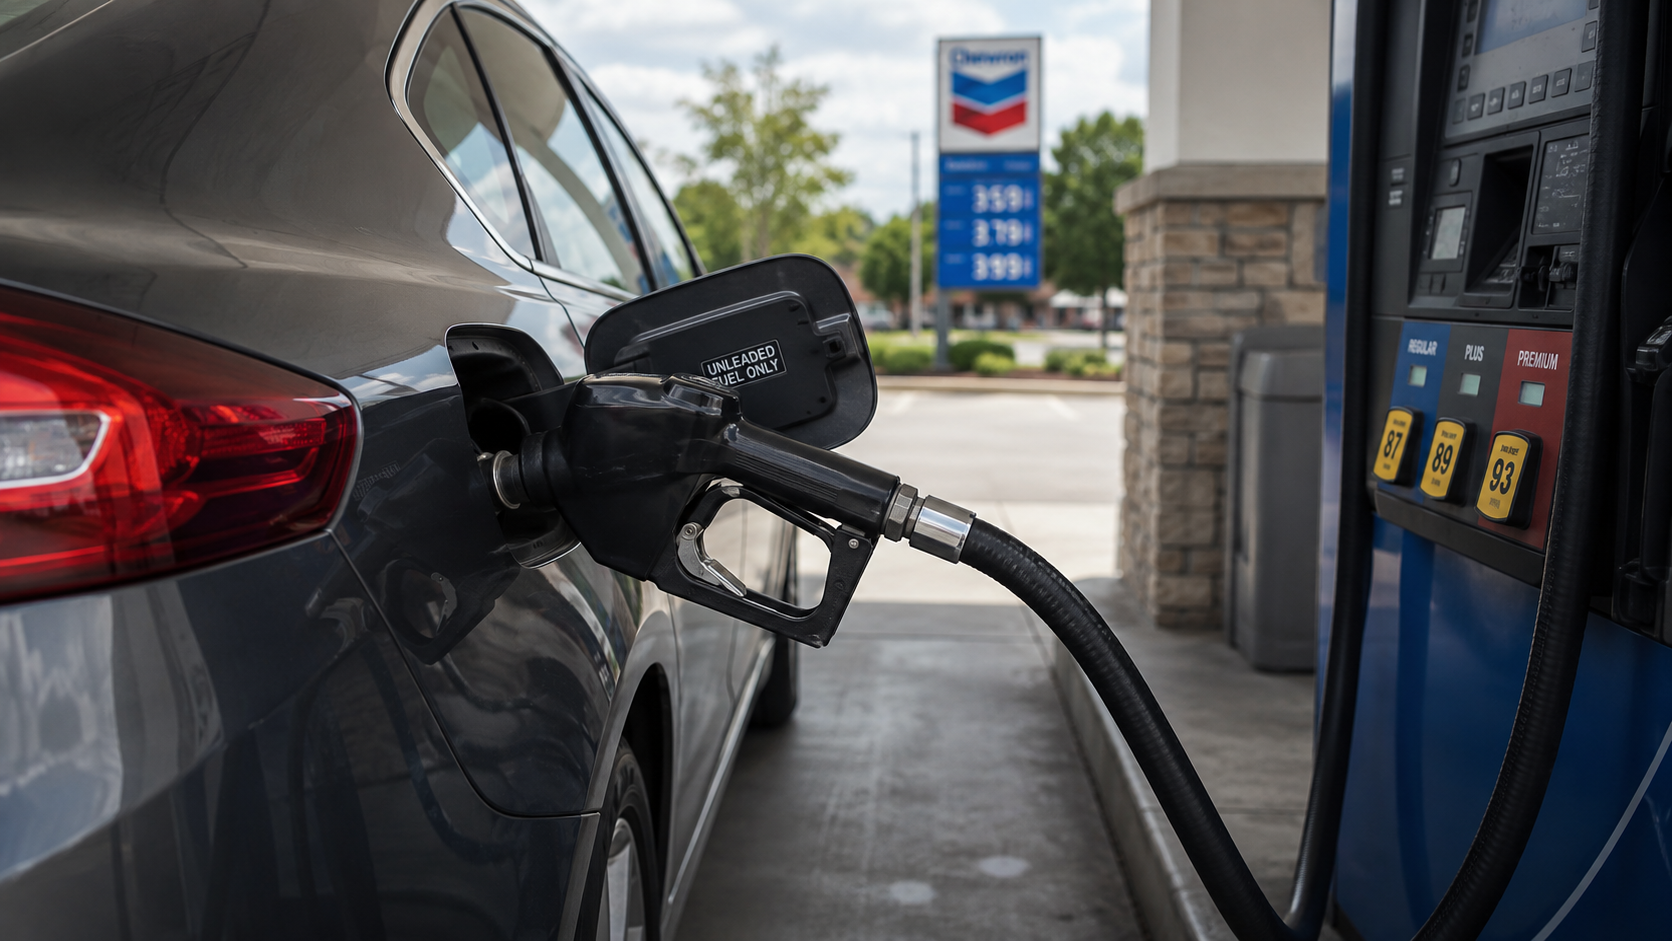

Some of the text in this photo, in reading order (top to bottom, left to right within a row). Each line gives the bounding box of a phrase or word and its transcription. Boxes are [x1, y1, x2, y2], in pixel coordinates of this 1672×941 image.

[1407, 338, 1438, 356] REGULAR
[1464, 344, 1485, 362] PLUS
[1516, 350, 1559, 370] PREMIUM
[707, 345, 775, 376] UNLEADED
[746, 358, 779, 379] ONLY
[1383, 429, 1404, 460] 87
[1432, 442, 1453, 475] 89
[1489, 458, 1515, 495] 93
